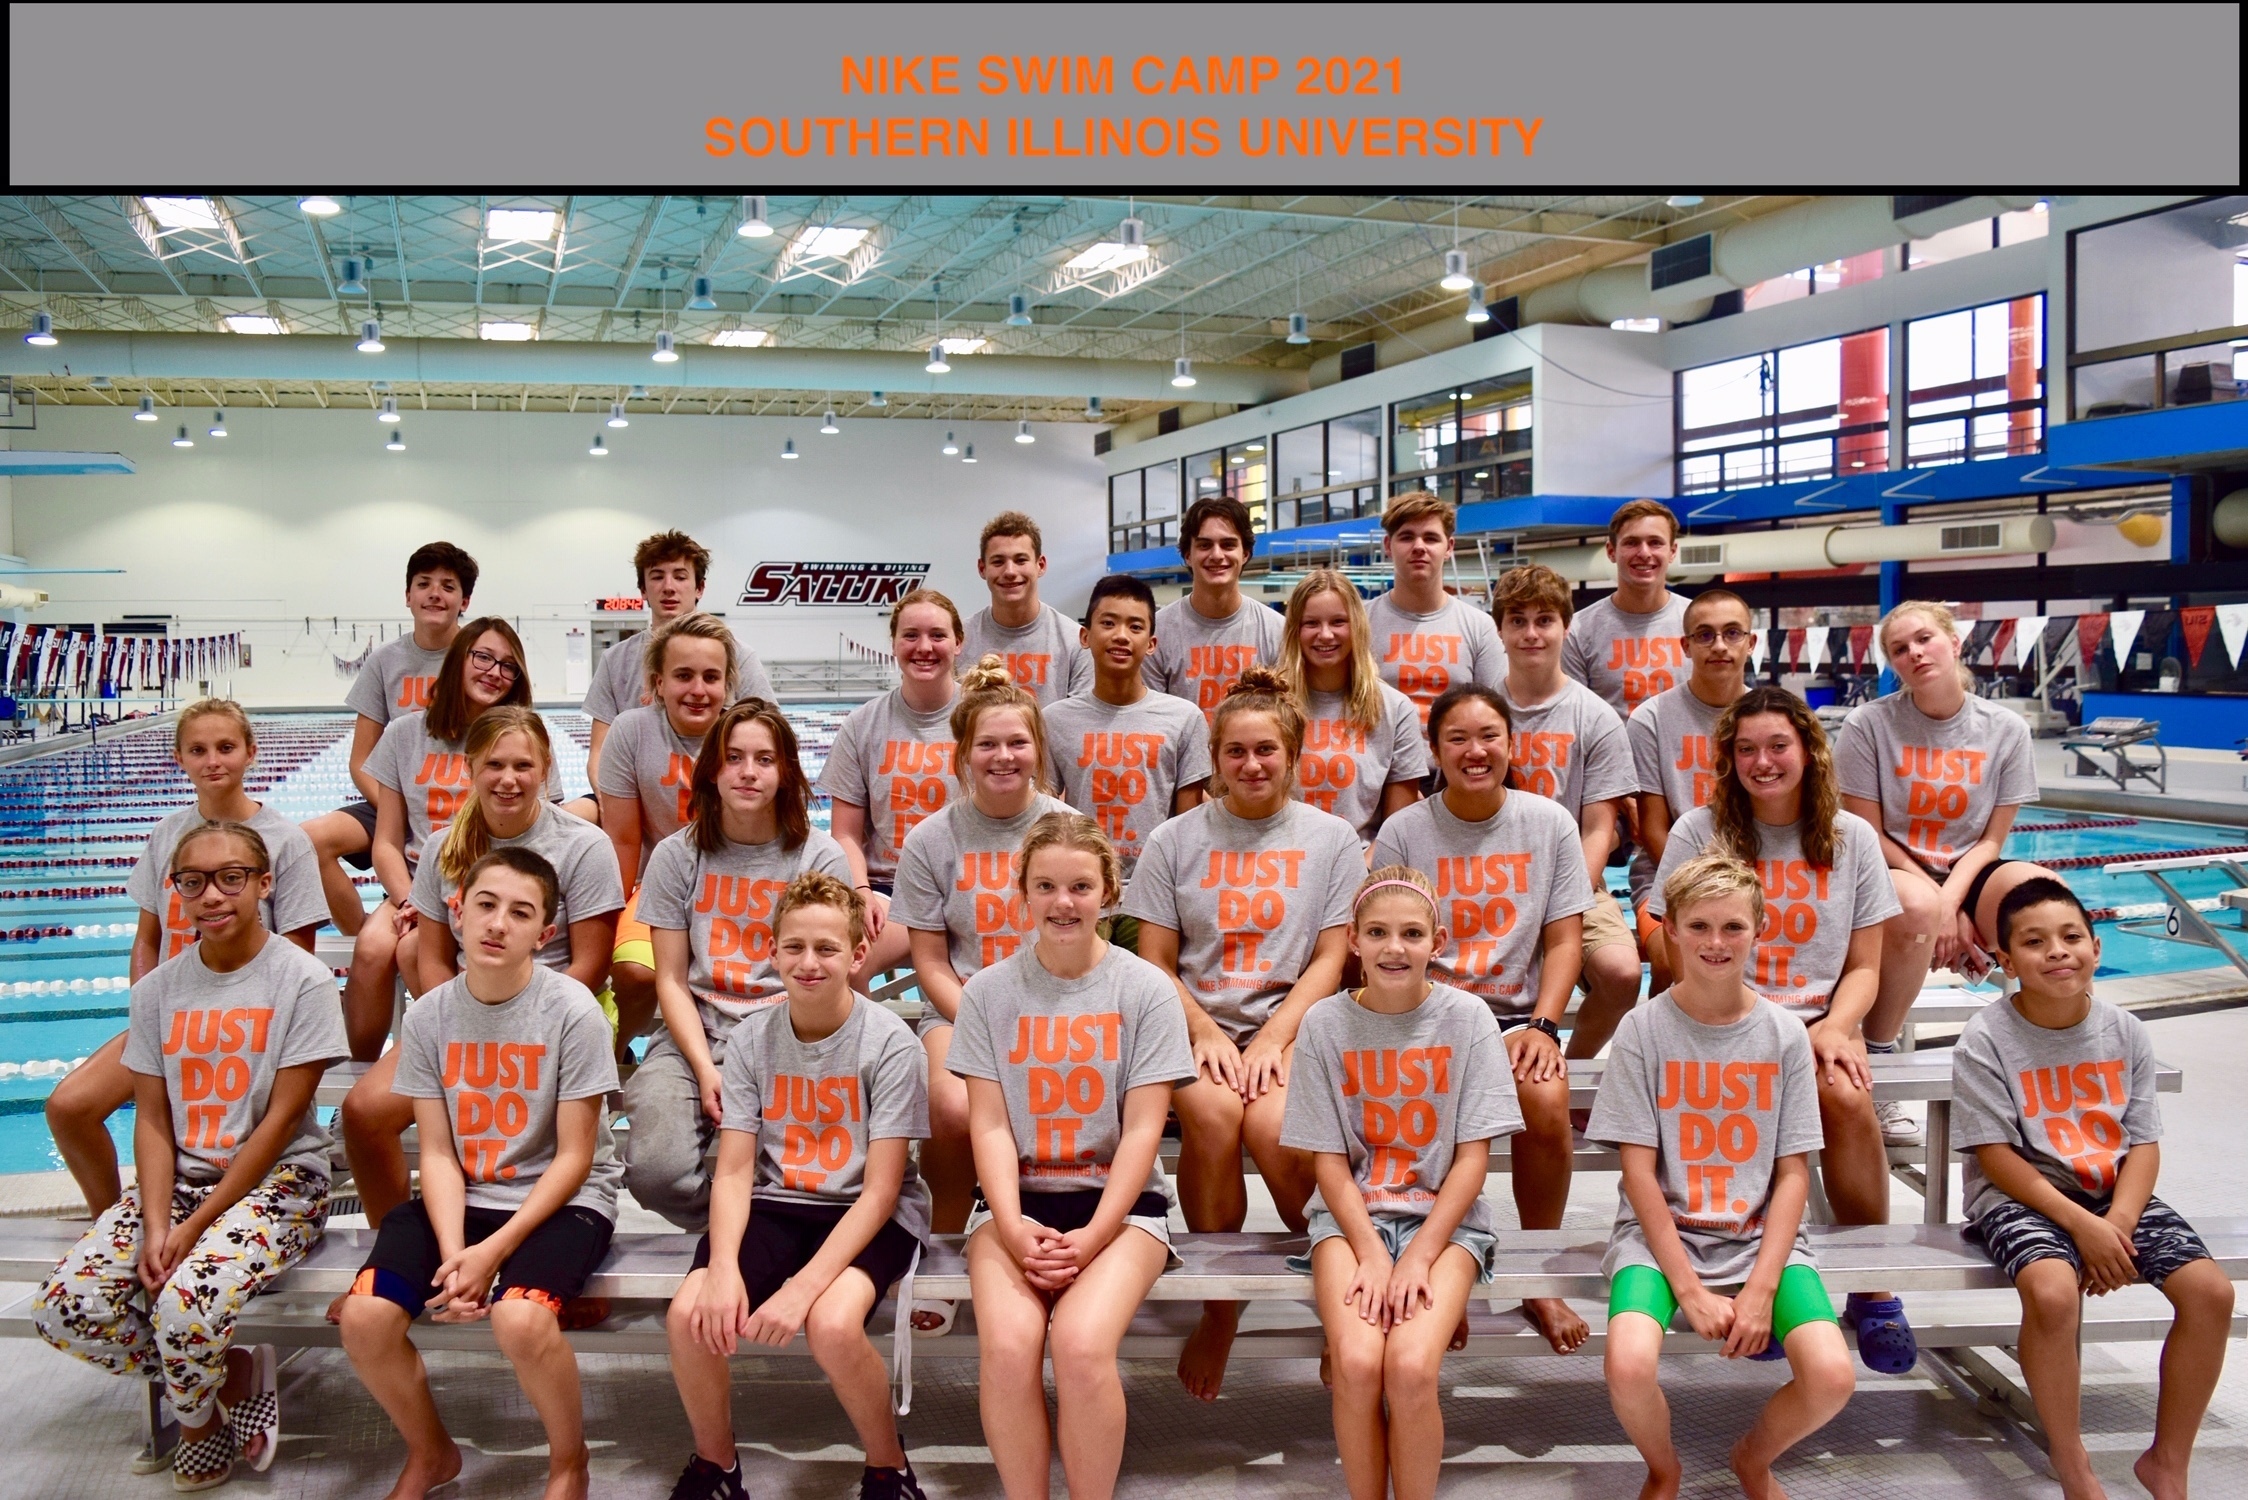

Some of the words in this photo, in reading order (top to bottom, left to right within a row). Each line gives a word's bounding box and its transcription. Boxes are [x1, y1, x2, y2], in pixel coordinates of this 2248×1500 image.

[802, 563, 865, 571] SWIMMING
[884, 564, 926, 572] DIVING
[997, 652, 1052, 685] UST
[1185, 645, 1257, 679] JUST
[1383, 633, 1462, 664] JUST
[1607, 636, 1682, 670] JUST
[397, 677, 438, 708] JU
[1397, 664, 1450, 695] DO
[1623, 669, 1674, 702] DO
[1077, 733, 1164, 769] JUST
[1510, 732, 1574, 768] UST
[1895, 746, 1986, 785] JUST
[1092, 769, 1147, 805] DO
[1300, 753, 1356, 789] DO
[889, 776, 946, 813] DO
[1907, 781, 1968, 820] DO
[1200, 850, 1305, 889] JUST
[1436, 853, 1532, 896] JUST
[1755, 860, 1834, 900] UST
[1218, 890, 1285, 930] DO
[1452, 897, 1516, 938] DO
[2167, 906, 2179, 936] 6
[709, 917, 773, 963] DO
[1223, 933, 1272, 972] IT.
[1454, 941, 1503, 976] IT.
[1218, 978, 1262, 991] SWIMMING
[1755, 946, 1807, 988] IT.
[163, 1008, 275, 1055] JUST
[1008, 1013, 1123, 1064] JUST
[181, 1056, 250, 1102] DO
[441, 1042, 546, 1090] JUST
[1341, 1046, 1453, 1098] JUST
[1657, 1061, 1779, 1111] JUST
[763, 1074, 861, 1123] JUST
[1028, 1065, 1105, 1115] DO
[2018, 1060, 2127, 1118] JUST
[185, 1105, 235, 1149] IT.
[457, 1091, 528, 1137] DO
[1363, 1099, 1437, 1147] DO
[2043, 1110, 2122, 1157] DO
[781, 1125, 853, 1172] DO
[1036, 1118, 1096, 1162] IT.
[1679, 1112, 1758, 1163] DO
[463, 1139, 517, 1182] IT.
[1034, 1164, 1091, 1177] SWIMMING
[1367, 1146, 1418, 1186] IT.
[1687, 1164, 1748, 1214] IT.
